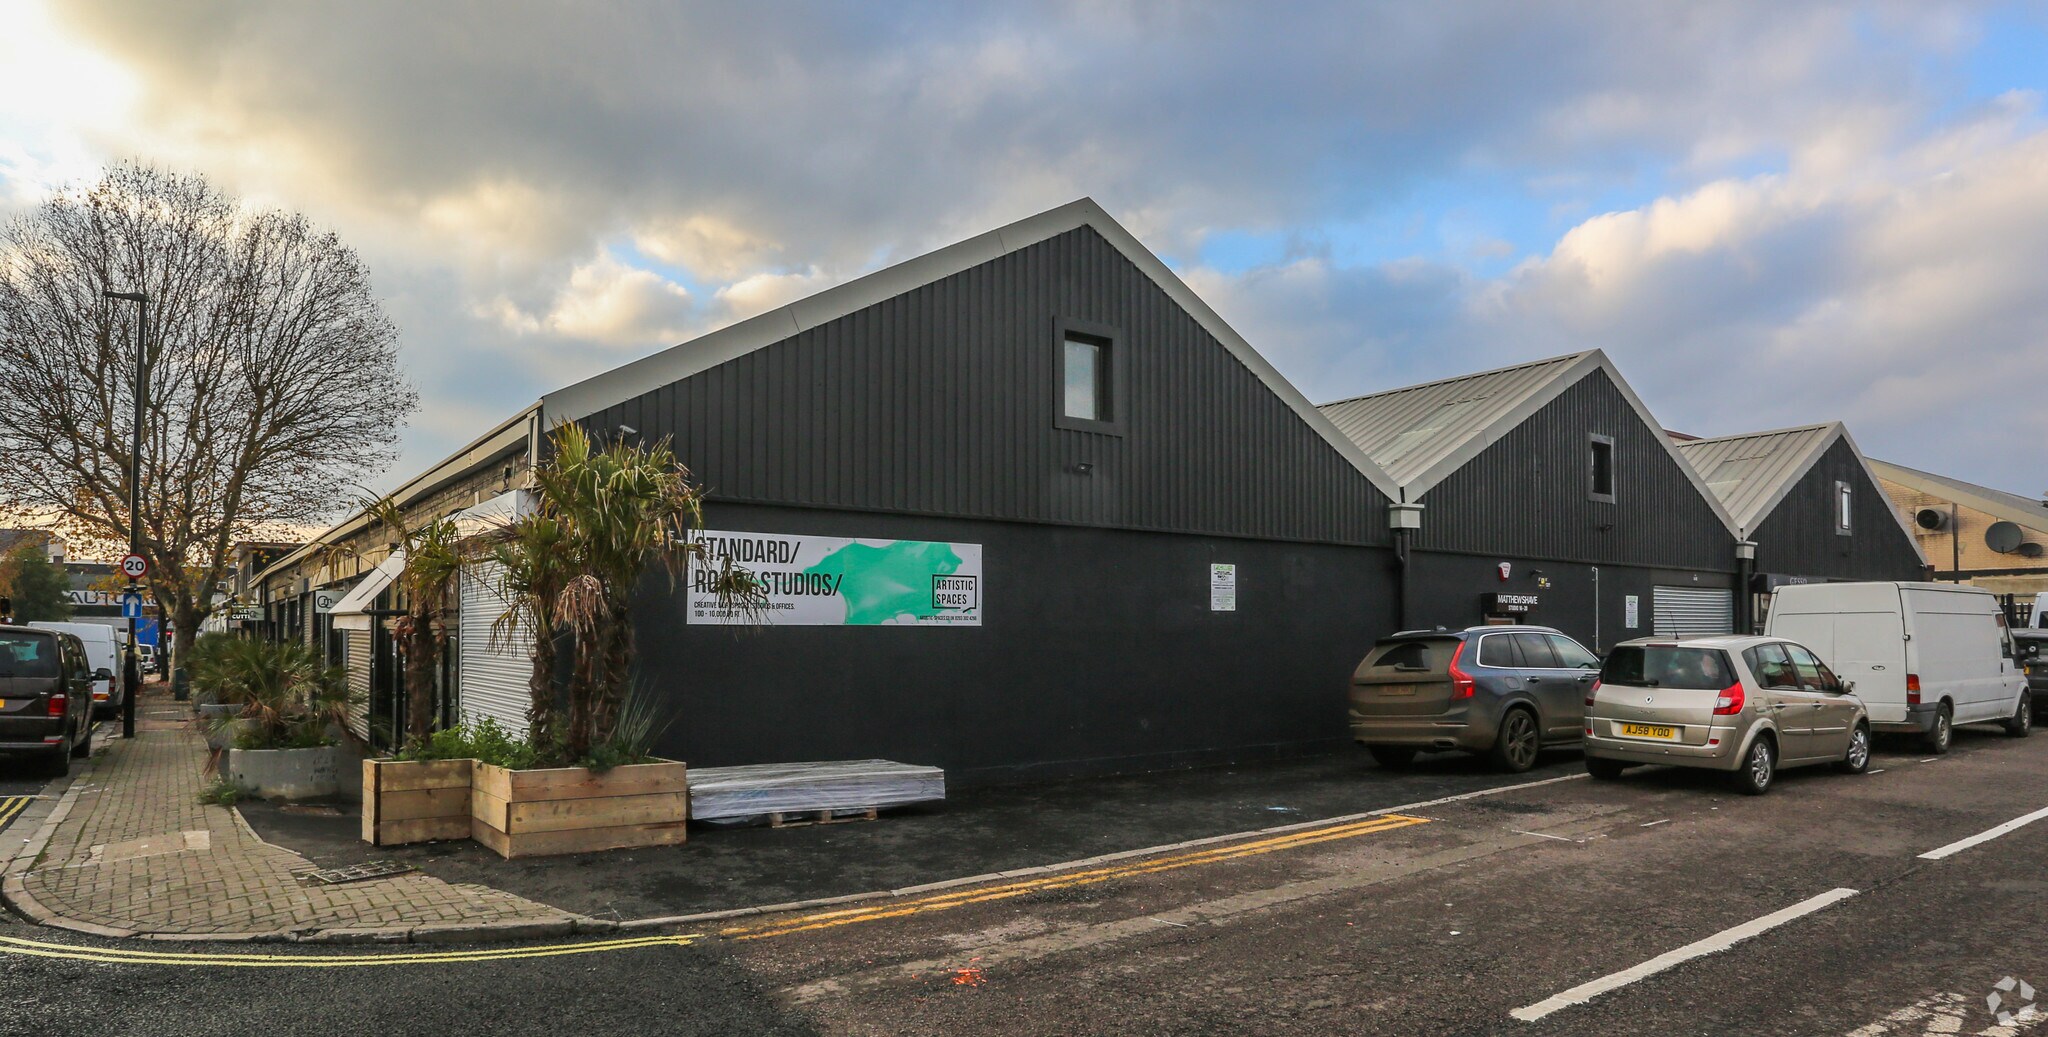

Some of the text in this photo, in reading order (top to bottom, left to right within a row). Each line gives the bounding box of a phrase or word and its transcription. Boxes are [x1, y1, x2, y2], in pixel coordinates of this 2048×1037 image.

[126, 560, 145, 571] 20
[760, 571, 843, 596] STUDIOS/
[936, 579, 973, 591] ARTISTIC
[936, 593, 967, 605] SPACES
[694, 601, 717, 609] CREATIVE
[1626, 725, 1650, 735] AJ58
